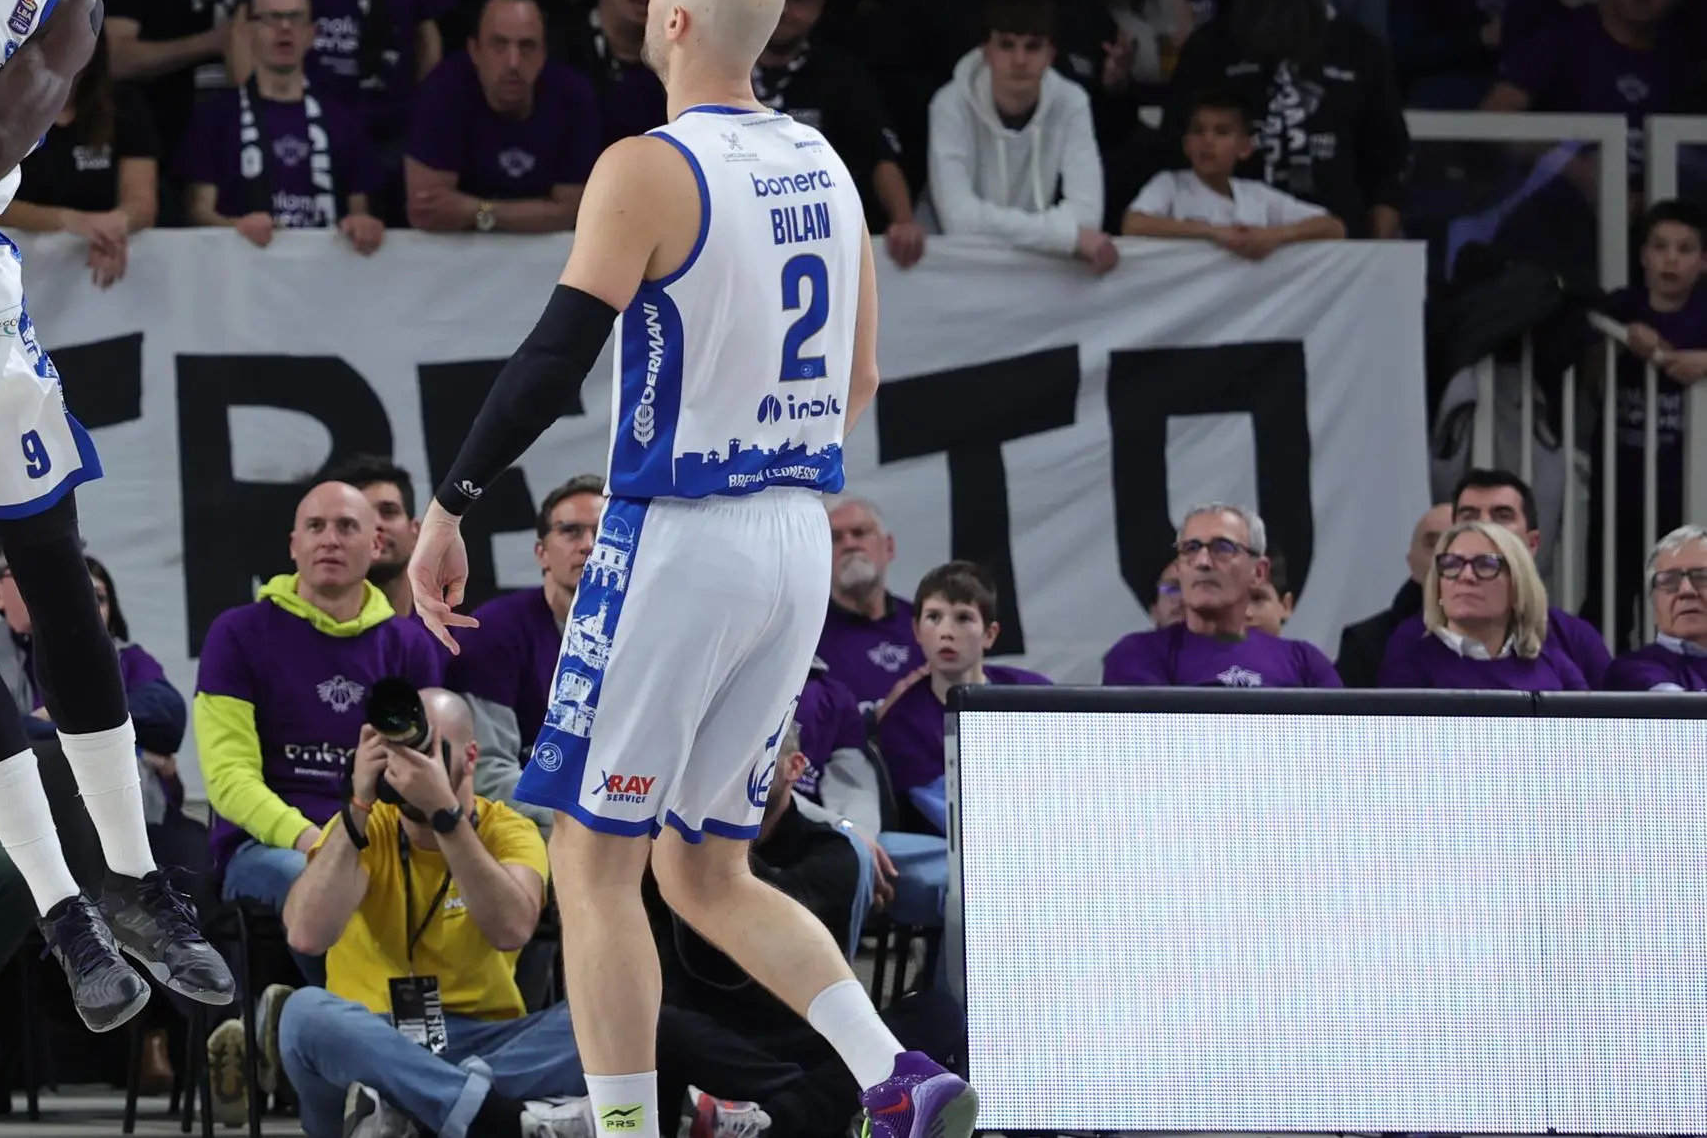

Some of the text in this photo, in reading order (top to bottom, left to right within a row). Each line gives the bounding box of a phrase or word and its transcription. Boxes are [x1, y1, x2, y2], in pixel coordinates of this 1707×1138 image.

[770, 202, 831, 246] BILAN
[779, 253, 830, 382] 2
[21, 429, 52, 480] 9
[606, 793, 647, 804] SERVICE
[606, 1119, 636, 1128] PRS
